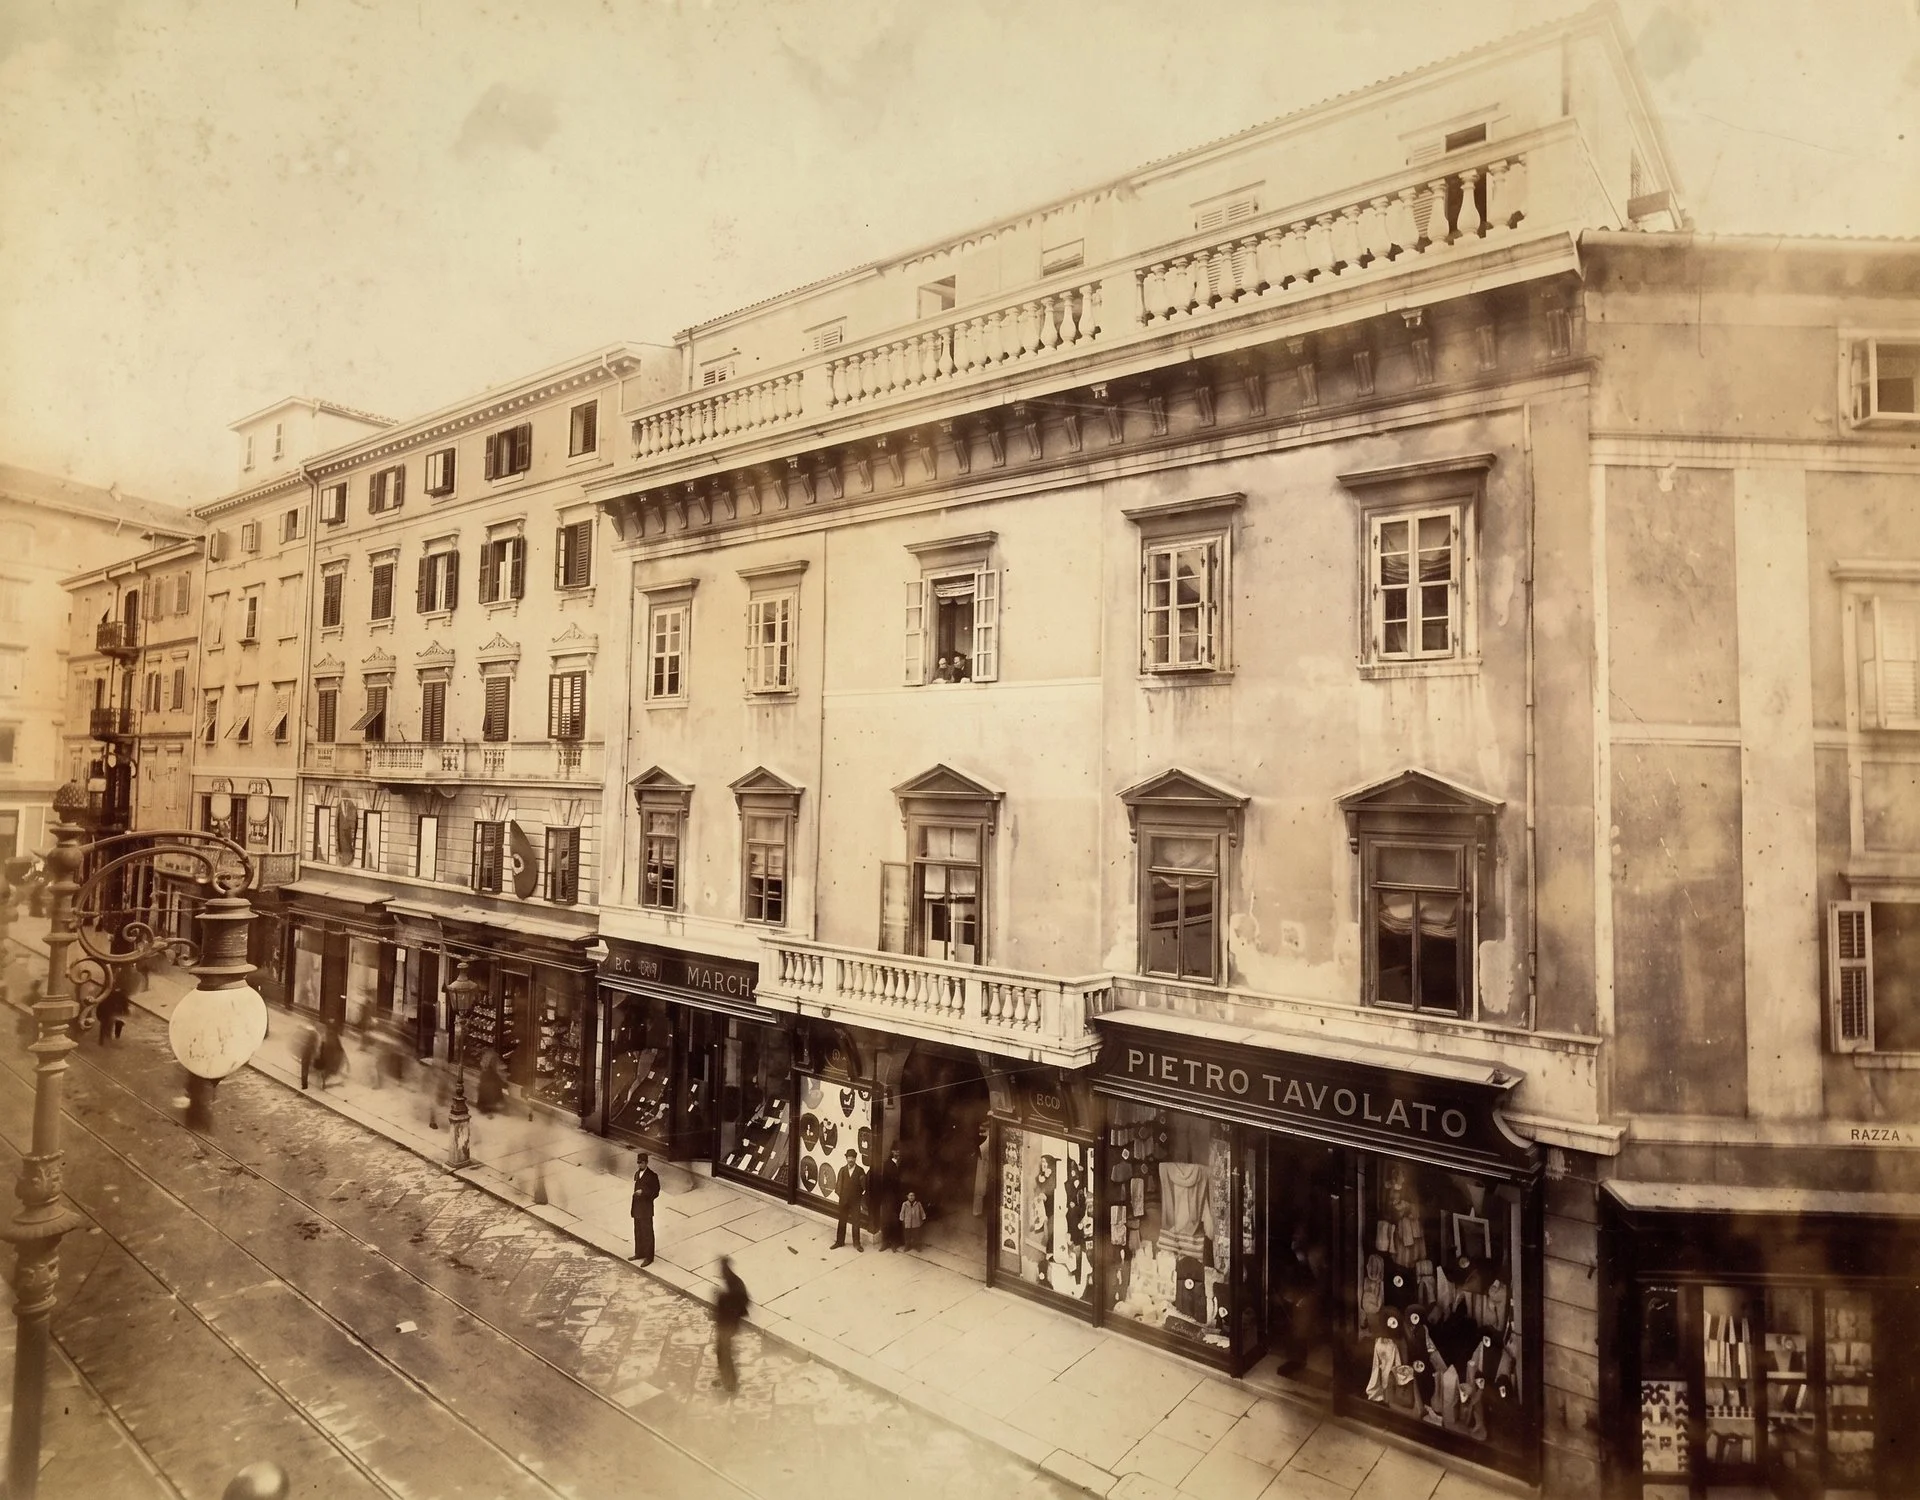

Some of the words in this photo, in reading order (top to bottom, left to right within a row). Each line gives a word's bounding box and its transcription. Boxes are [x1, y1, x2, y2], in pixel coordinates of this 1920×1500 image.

[687, 966, 750, 997] MARCH
[1128, 1049, 1249, 1095] PIETRO
[1262, 1074, 1467, 1138] TAVOLATO
[1851, 1128, 1900, 1141] RAZZA
